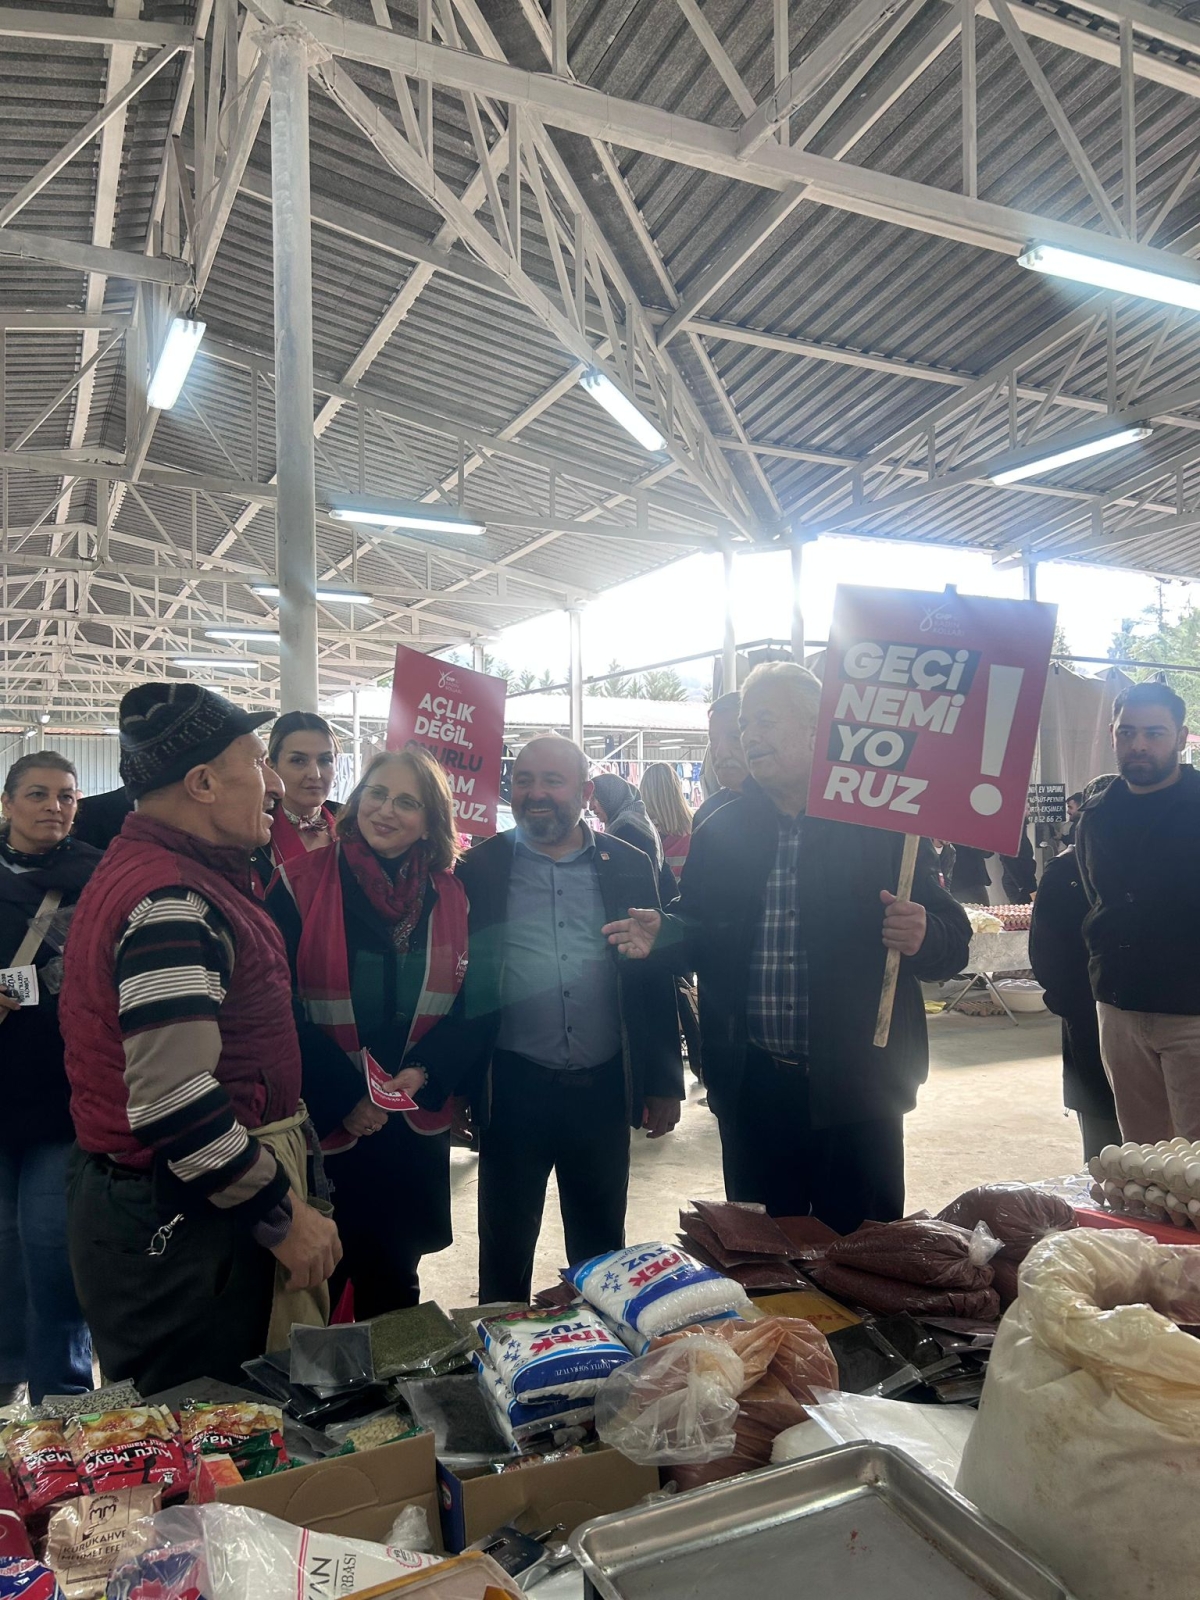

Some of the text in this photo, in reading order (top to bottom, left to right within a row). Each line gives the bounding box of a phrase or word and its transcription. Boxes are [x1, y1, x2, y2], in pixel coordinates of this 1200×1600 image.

[417, 692, 476, 724] AÇLIK
[836, 724, 905, 767] YO
[823, 766, 929, 815] RUZ
[531, 1321, 591, 1339] TUZ
[85, 1445, 173, 1475] Kuru Maya
[116, 1440, 147, 1451] Hamur
[26, 1453, 72, 1472] Maya
